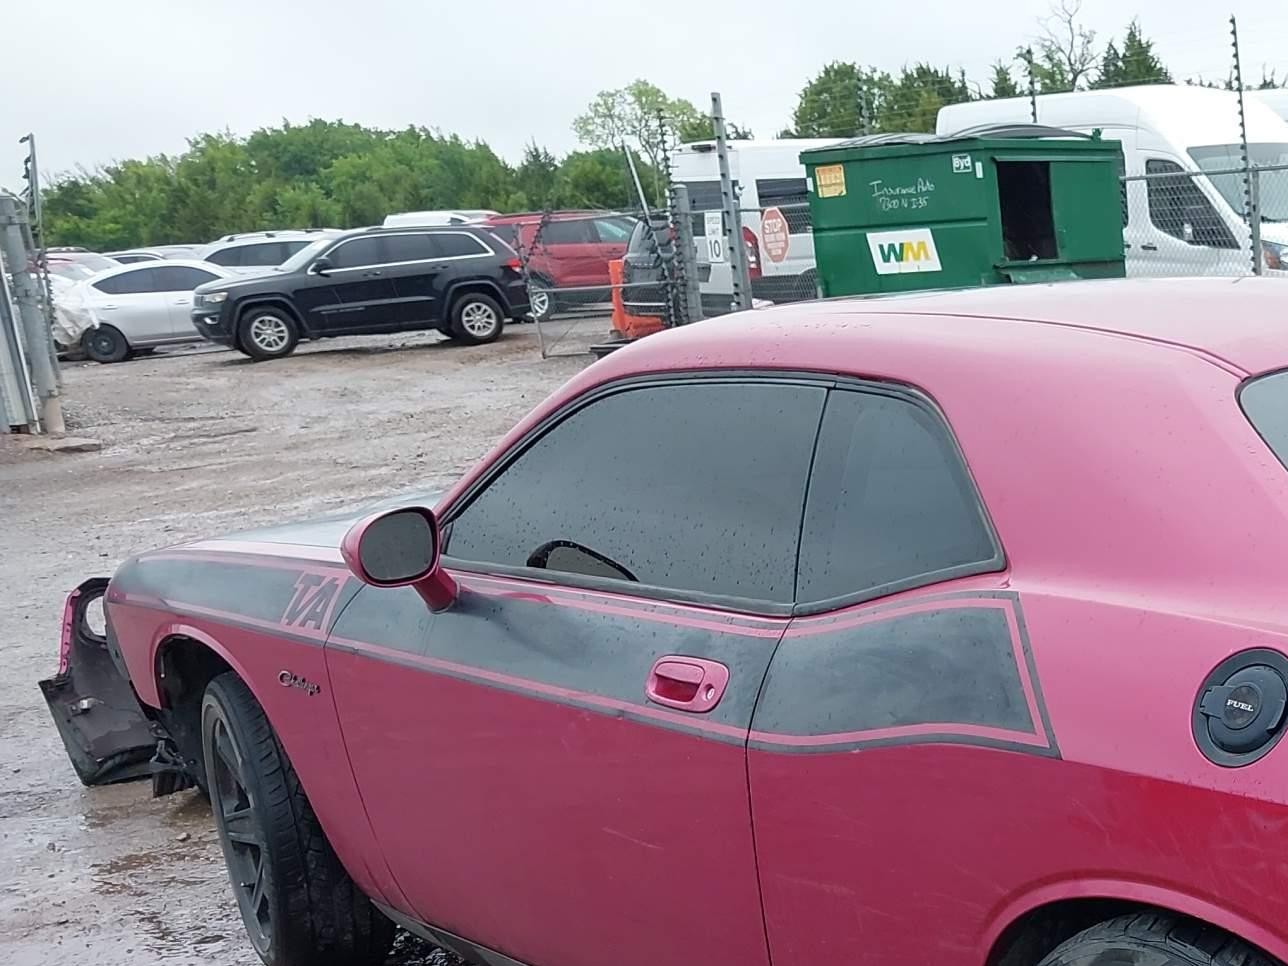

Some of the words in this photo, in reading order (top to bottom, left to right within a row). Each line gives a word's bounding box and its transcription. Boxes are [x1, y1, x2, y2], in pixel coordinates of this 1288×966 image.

[764, 219, 783, 234] STOP
[709, 239, 721, 258] 10
[878, 241, 930, 264] WM
[1226, 699, 1254, 712] FUEL
